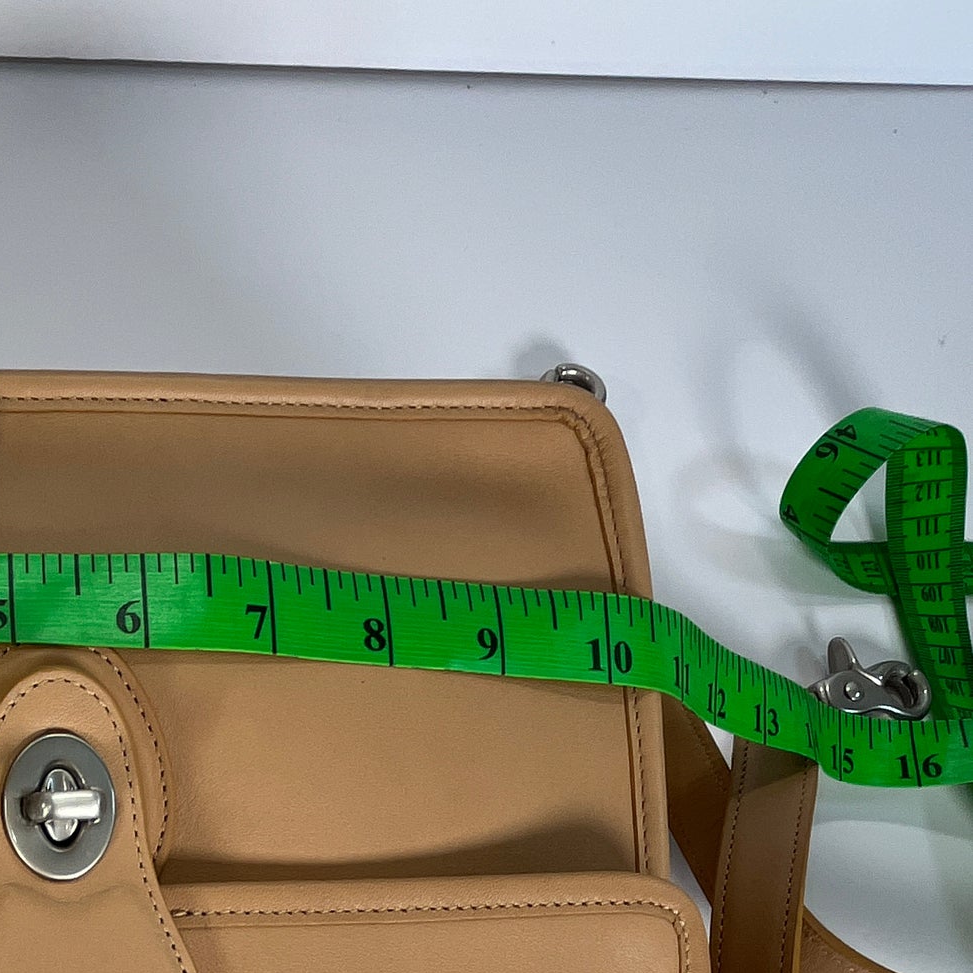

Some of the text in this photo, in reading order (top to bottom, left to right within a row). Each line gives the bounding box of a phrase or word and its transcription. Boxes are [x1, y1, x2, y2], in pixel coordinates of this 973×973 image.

[916, 482, 939, 502] 112
[116, 600, 141, 634] 6
[245, 604, 268, 640] 7
[362, 618, 387, 651] 8
[477, 628, 499, 661] 9
[586, 638, 632, 674] 10
[673, 656, 690, 696] 11
[707, 682, 726, 719] 12
[753, 703, 779, 737] 13
[831, 744, 854, 774] 15
[897, 754, 943, 780] 16
